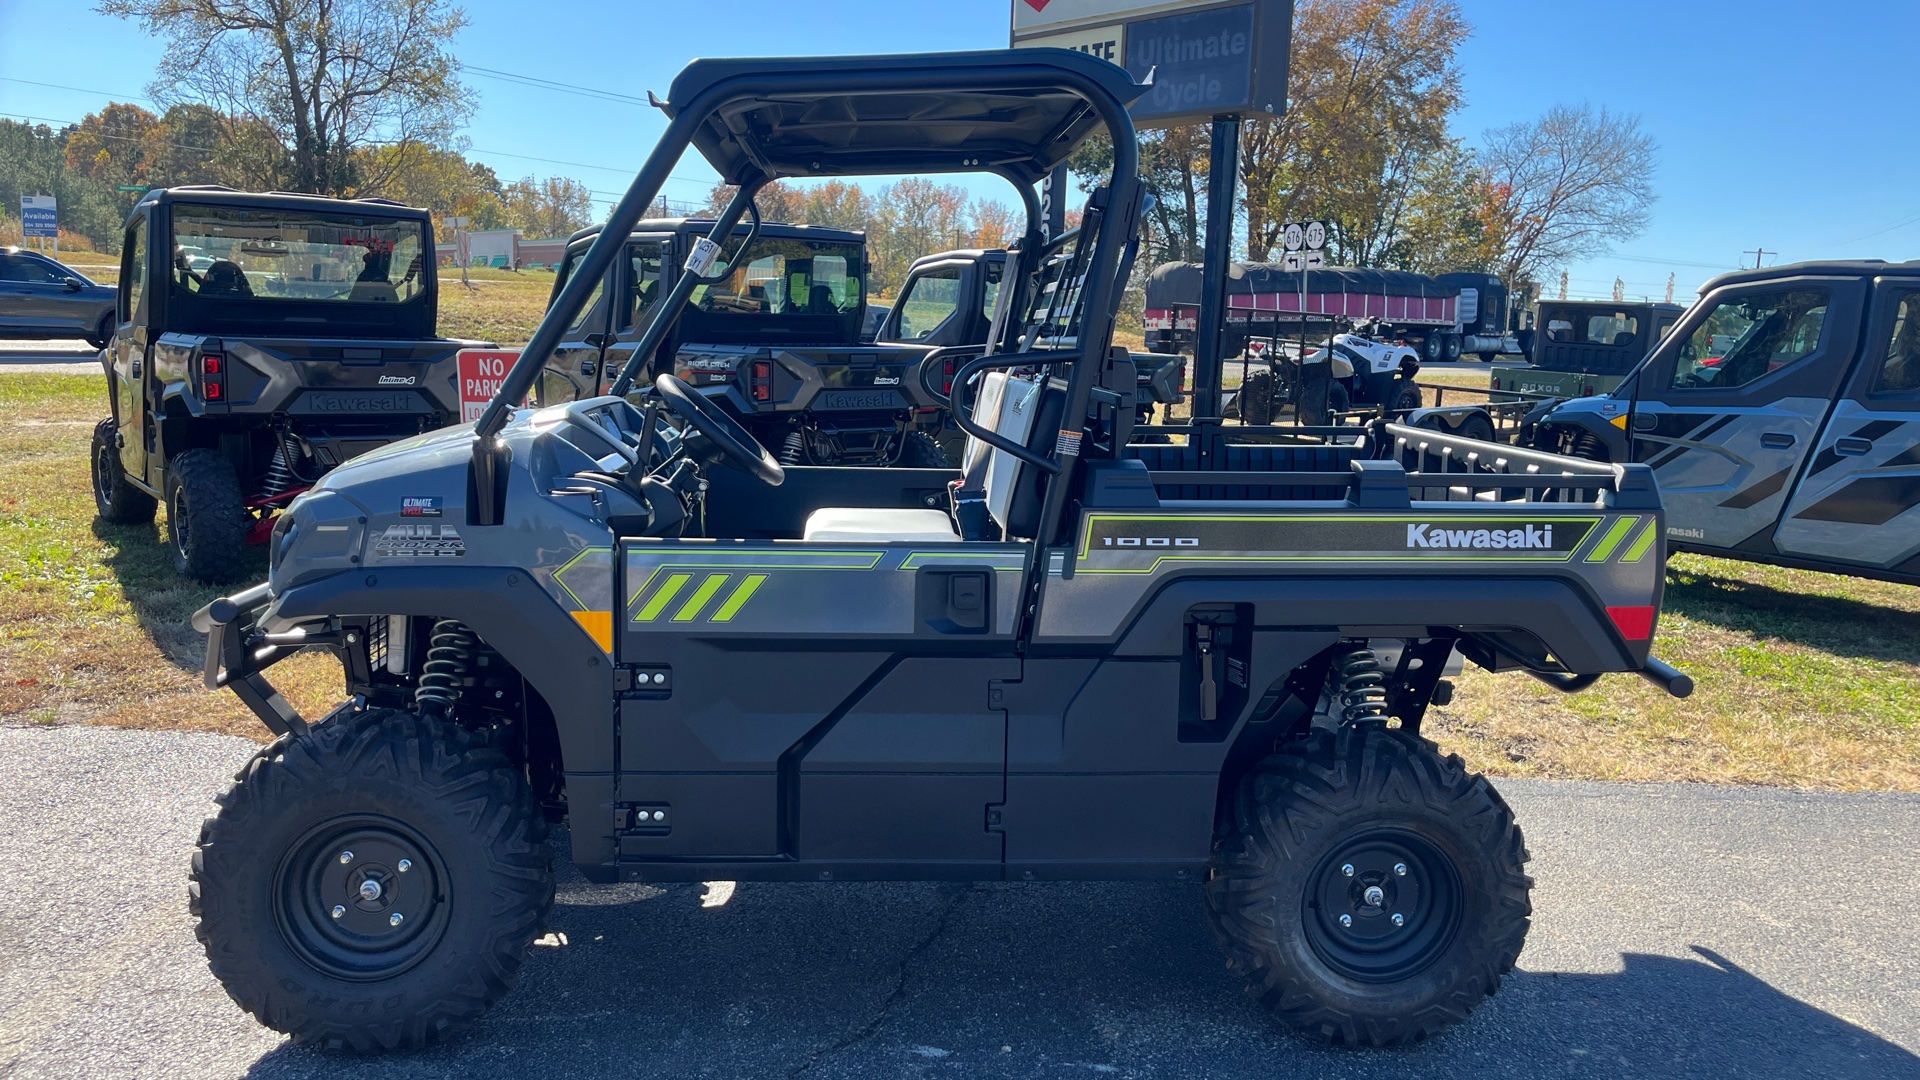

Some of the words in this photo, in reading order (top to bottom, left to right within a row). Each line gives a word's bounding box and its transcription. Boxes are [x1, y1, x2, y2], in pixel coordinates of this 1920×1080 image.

[1138, 28, 1246, 67] Ultimate
[1152, 74, 1221, 112] Cycle
[23, 212, 56, 220] Available
[1286, 230, 1300, 244] 676
[1308, 229, 1323, 242] 675
[478, 358, 505, 376] NO
[1521, 382, 1561, 393] ROXOR
[310, 393, 413, 411] Kawasaki
[825, 391, 894, 408] Kawasaki
[403, 498, 433, 507] ULTIMATE
[380, 524, 462, 541] MULE
[1406, 523, 1553, 549] Kawasaki
[1103, 537, 1199, 546] 1000
